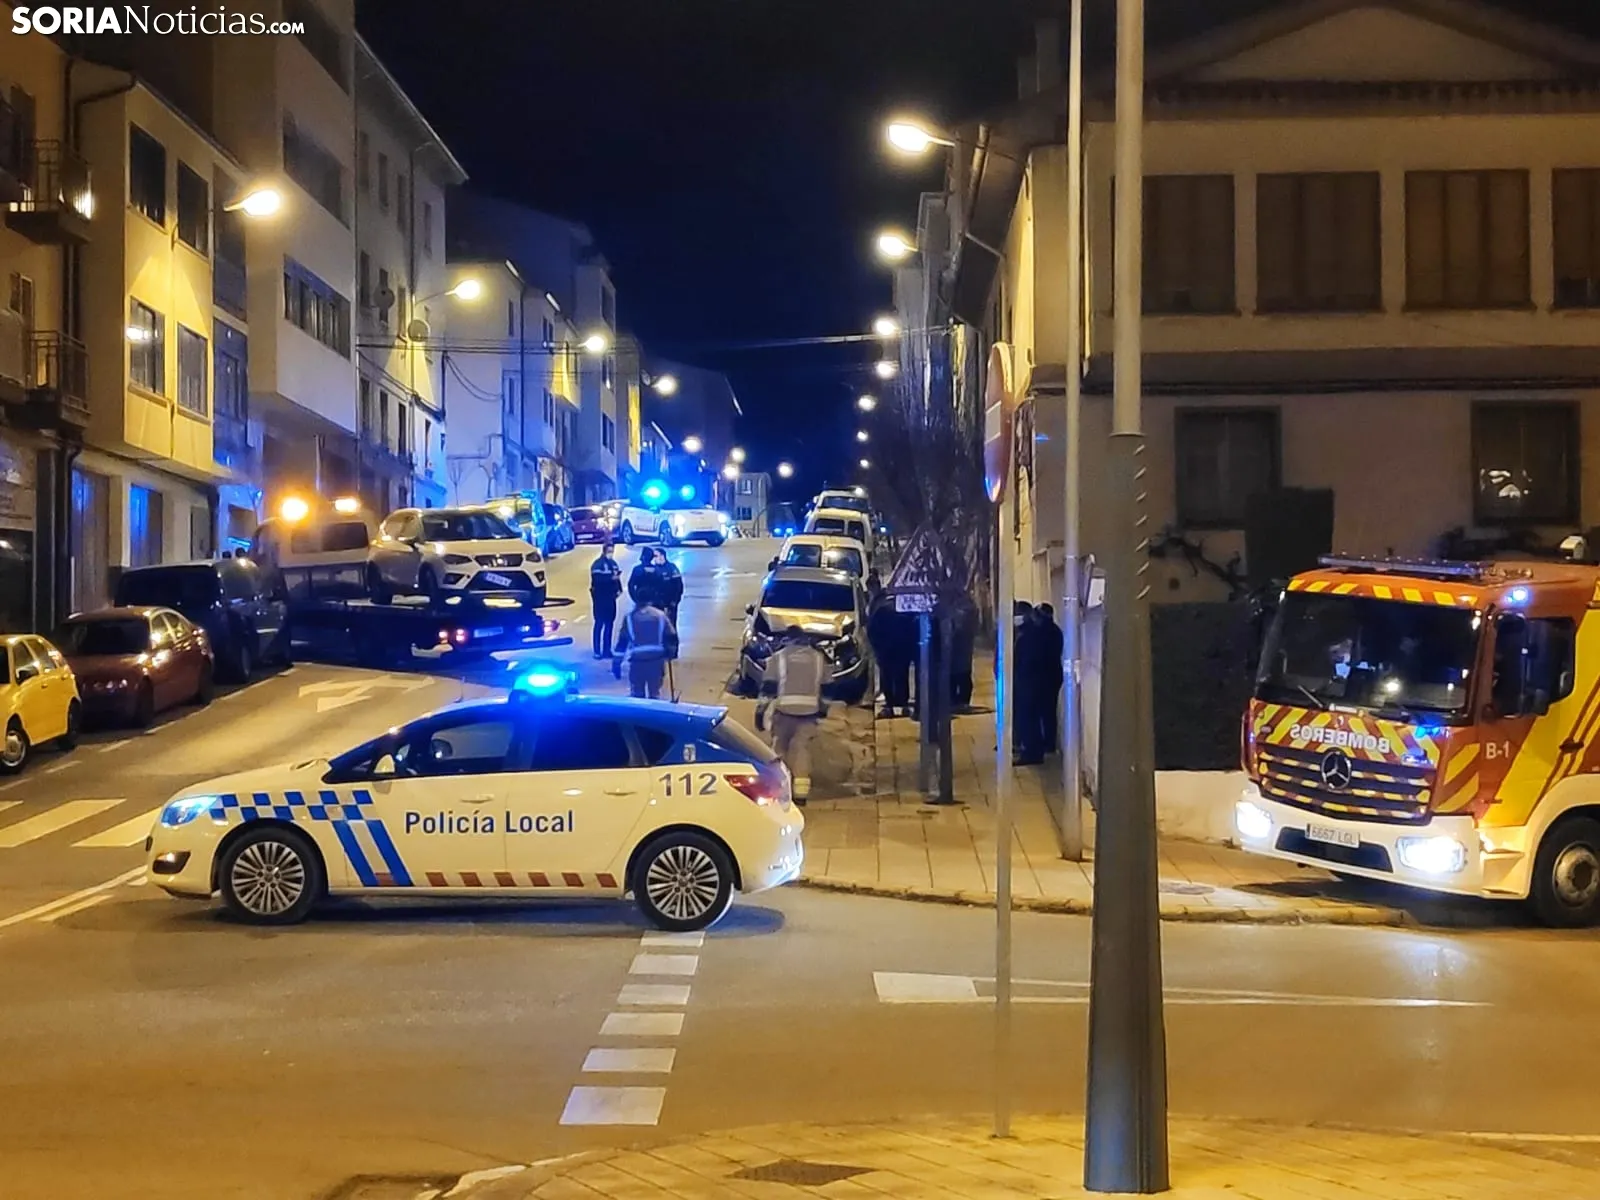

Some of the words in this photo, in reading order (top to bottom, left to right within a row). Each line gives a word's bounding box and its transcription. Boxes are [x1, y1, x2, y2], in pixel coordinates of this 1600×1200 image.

[1485, 740, 1510, 760] B-1
[659, 772, 719, 798] 112
[405, 810, 495, 834] Policía
[505, 809, 574, 833] Local
